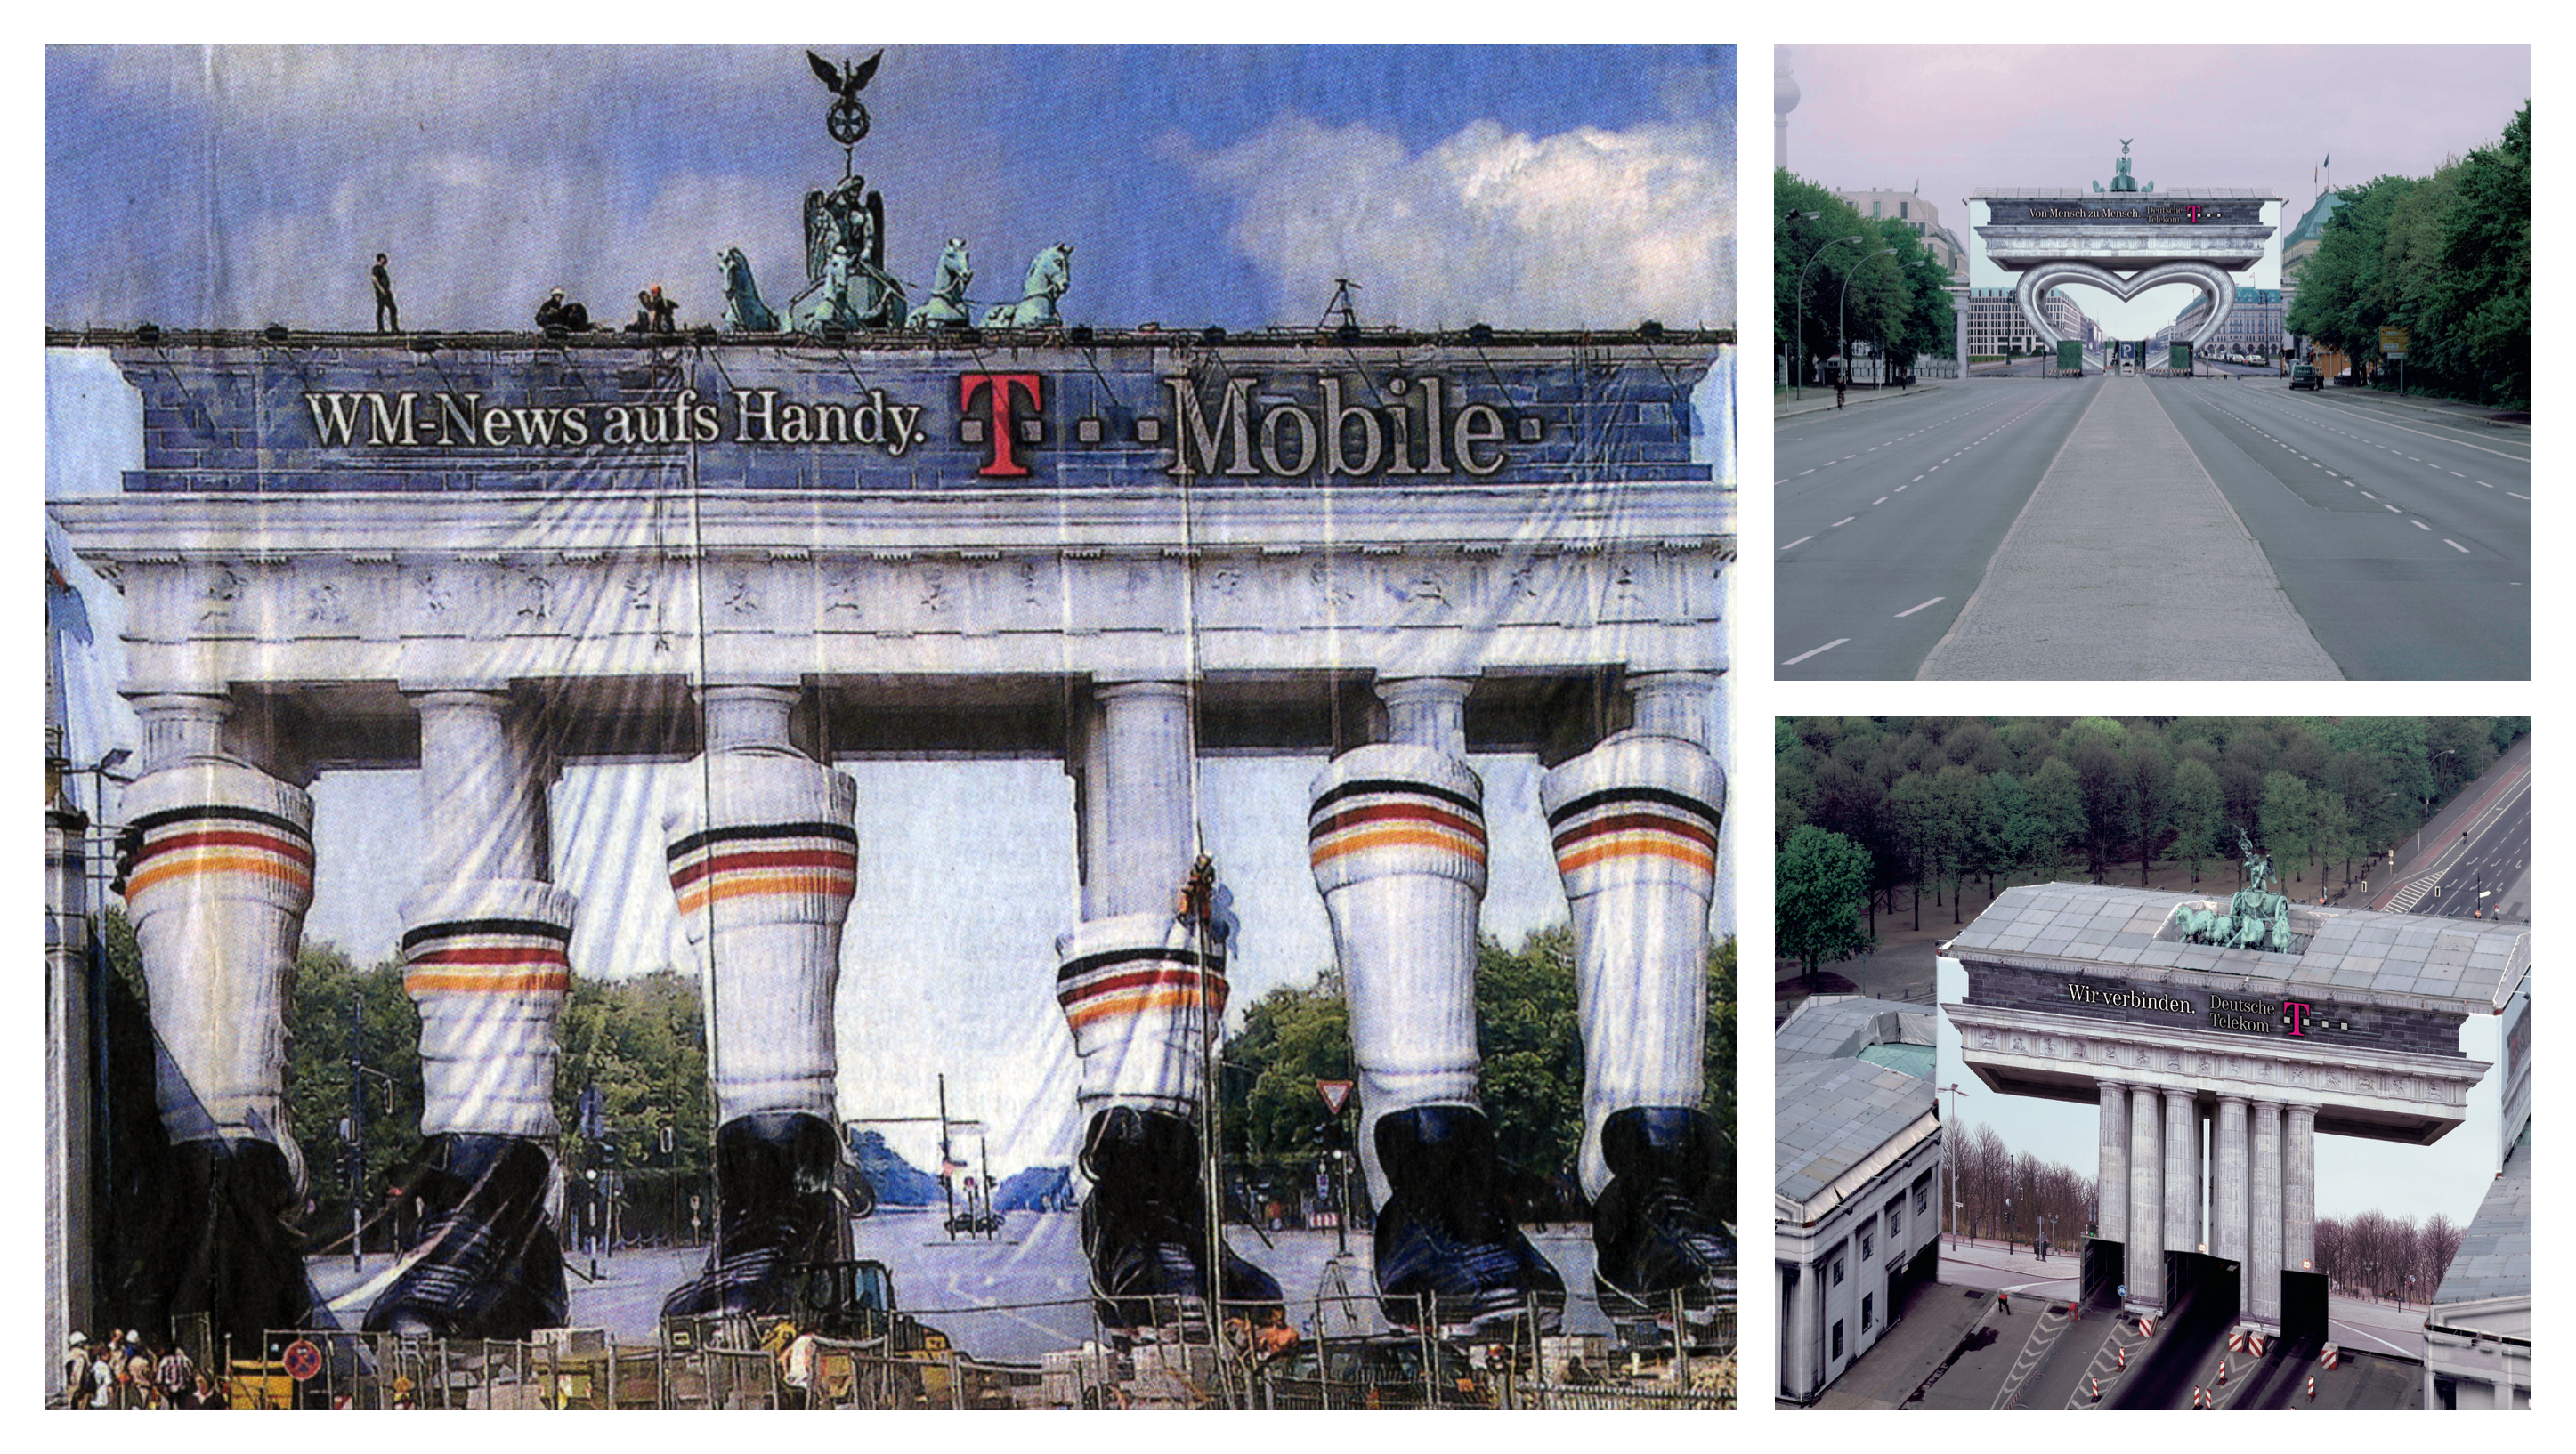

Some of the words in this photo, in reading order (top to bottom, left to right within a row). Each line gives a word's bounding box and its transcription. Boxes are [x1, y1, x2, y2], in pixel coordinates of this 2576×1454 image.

[2029, 208, 2047, 218] Von
[2049, 208, 2086, 218] Mensch
[2088, 210, 2100, 218] zu
[2102, 208, 2142, 218] Mensch.
[2146, 206, 2183, 214] Deutsche
[2146, 215, 2180, 223] Telekom
[2186, 206, 2201, 223] T
[2123, 344, 2132, 358] P
[305, 392, 589, 446] WM-News
[603, 389, 719, 444] aufs
[732, 390, 926, 456] Handy.
[1163, 376, 1506, 476] Mobile
[2068, 983, 2100, 1004] Wir
[2102, 990, 2196, 1014] verbinden.
[2209, 994, 2275, 1015] Deutsche
[2209, 1012, 2270, 1033] Telekom
[2283, 1001, 2310, 1037] T
